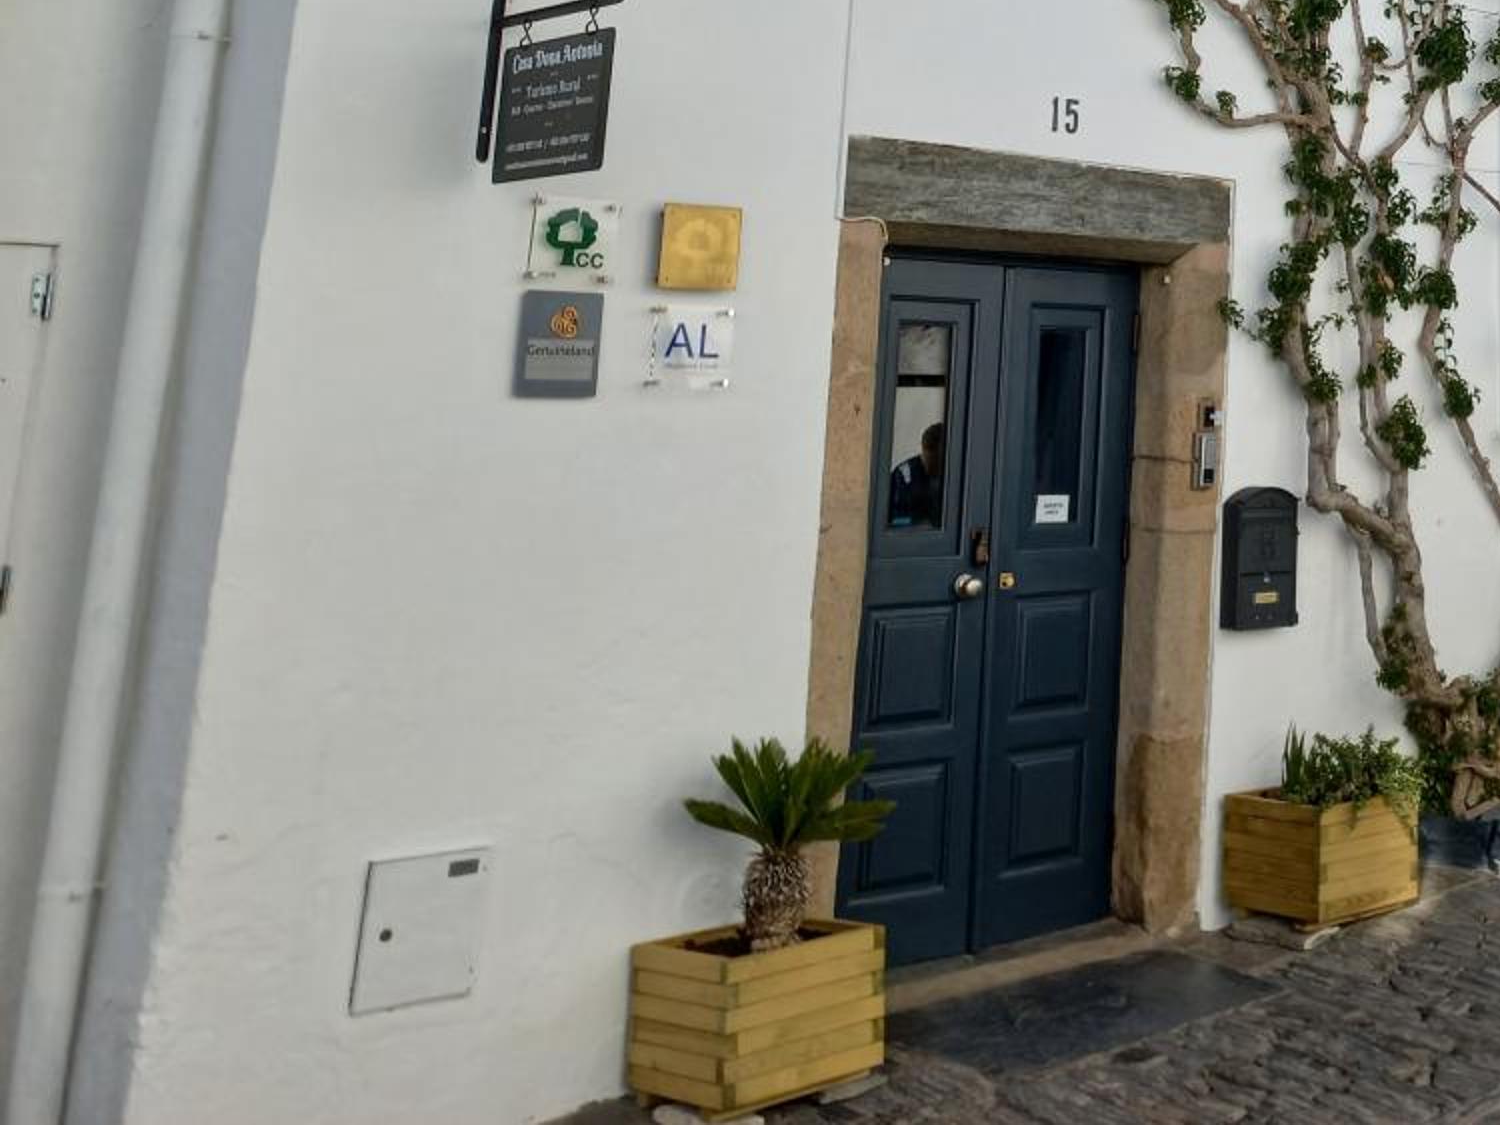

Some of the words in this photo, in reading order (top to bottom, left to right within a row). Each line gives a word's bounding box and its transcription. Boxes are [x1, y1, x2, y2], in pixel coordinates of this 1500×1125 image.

[513, 54, 533, 74] Casa
[536, 49, 562, 67] Dona
[559, 75, 581, 93] Rural
[1051, 96, 1080, 134] 15
[576, 252, 604, 270] CC
[664, 322, 720, 360] AL
